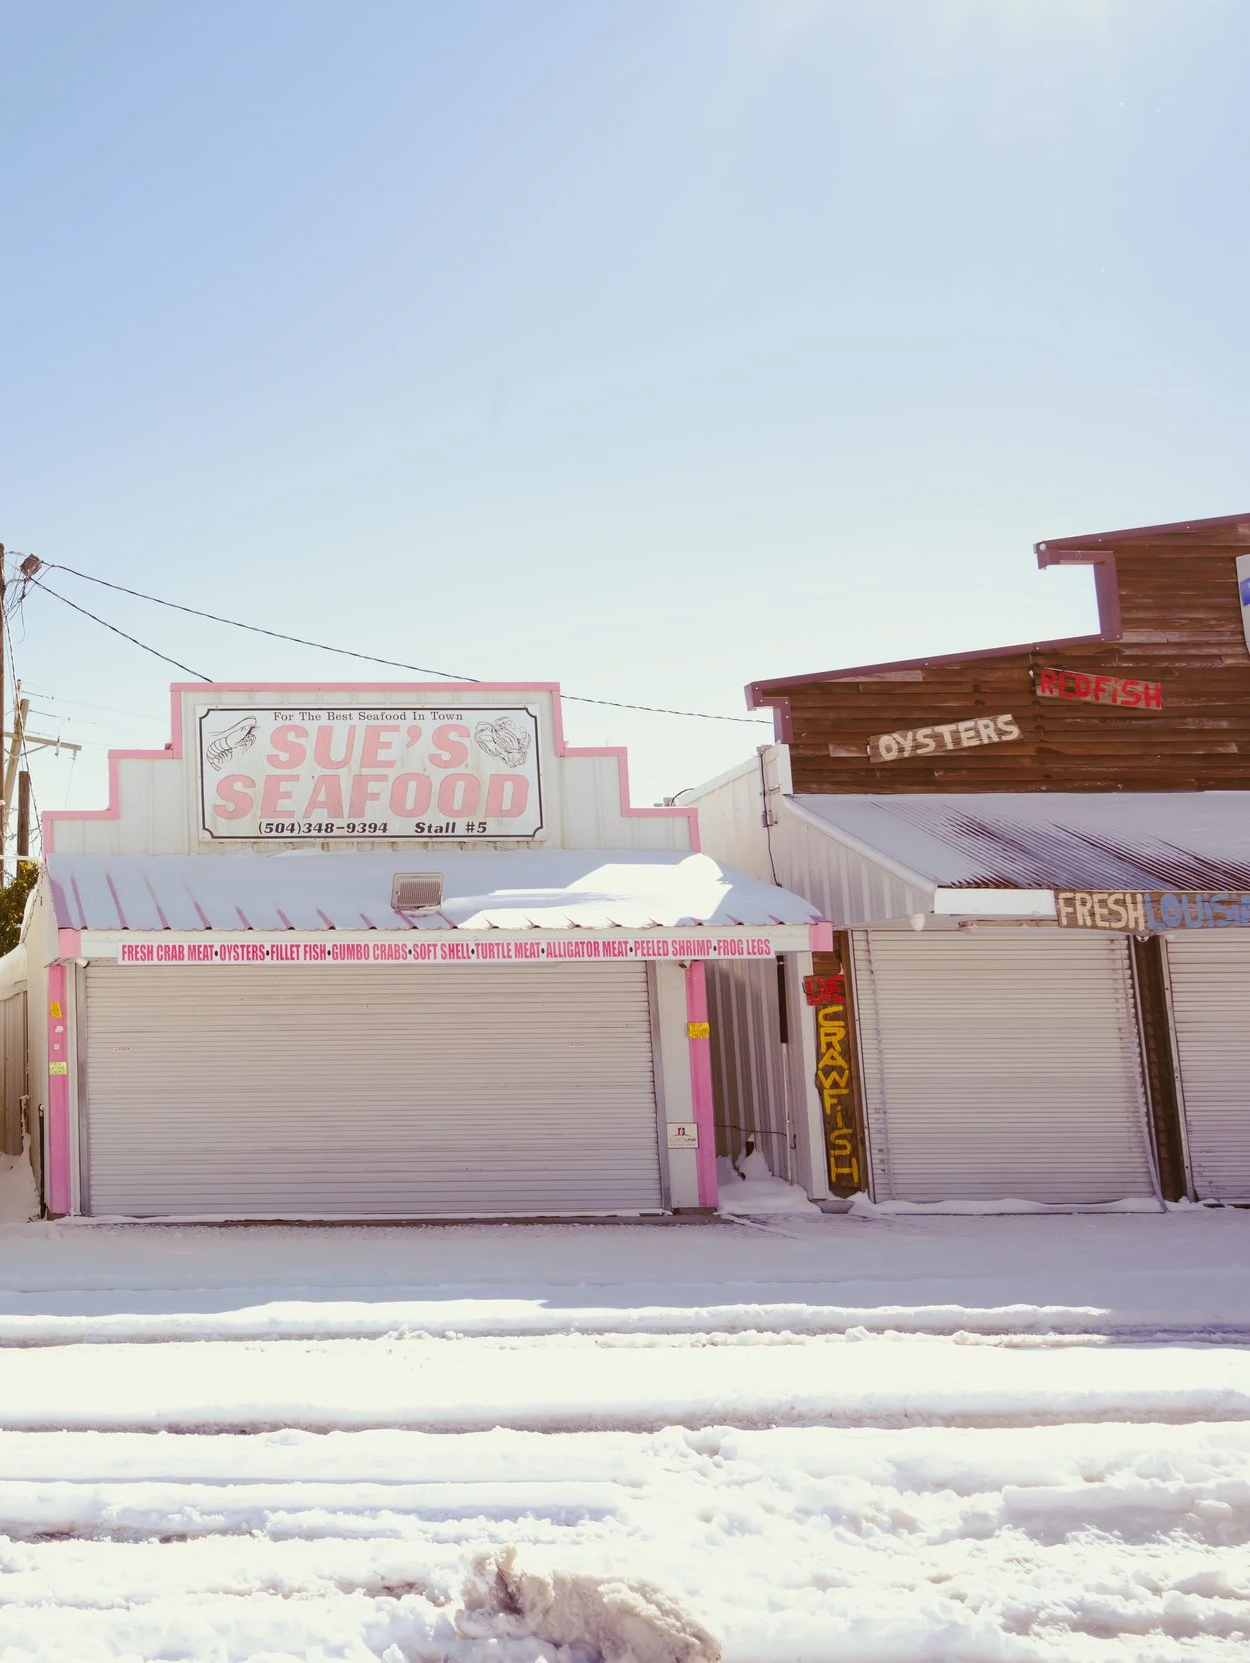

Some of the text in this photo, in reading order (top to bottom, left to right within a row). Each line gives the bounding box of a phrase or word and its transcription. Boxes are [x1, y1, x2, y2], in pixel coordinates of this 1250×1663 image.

[273, 711, 463, 721] For The Best Seafood In Town
[878, 714, 1021, 761] OYSTERS
[212, 773, 530, 820] SEAFOOD
[258, 821, 389, 835] (504)348-9394
[414, 821, 487, 834] Stall #5
[1058, 892, 1144, 931] FRESH
[121, 938, 771, 961] FRESH CRAB MEAT OYSTERS FILLET FISH GUMBO CRABS SOFT SHELL TURTLE MEAT ALLIGATOR MEAT PEELED SHRIMP FROG LEGS
